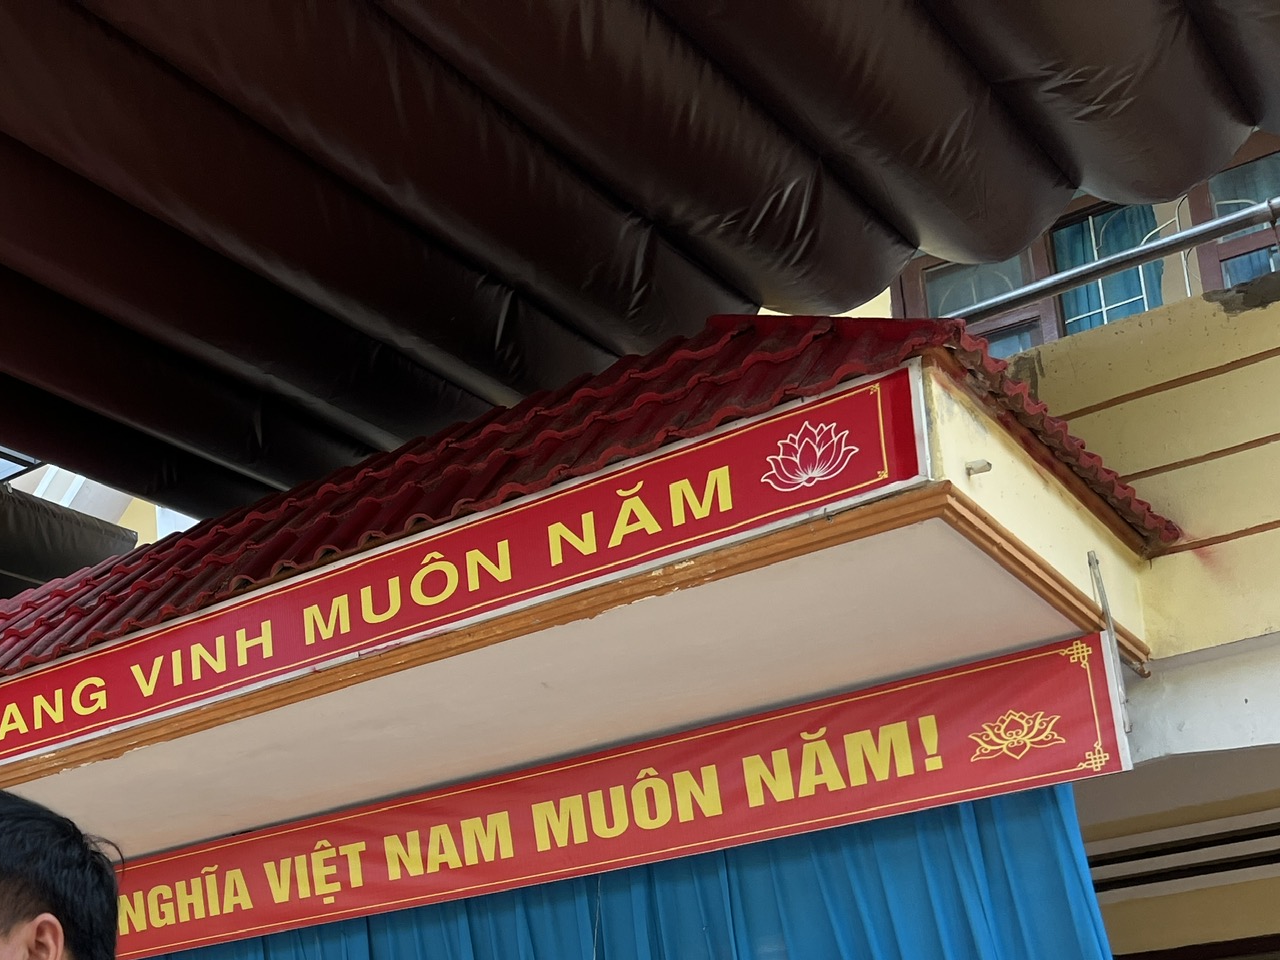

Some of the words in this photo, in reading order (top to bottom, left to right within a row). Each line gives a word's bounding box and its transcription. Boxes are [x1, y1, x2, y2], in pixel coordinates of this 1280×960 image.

[130, 619, 276, 699] VINH
[303, 539, 514, 645] MUÔN
[547, 465, 736, 567] NĂM
[118, 864, 253, 936] NGHĨA
[263, 840, 367, 905] VIỆT
[383, 810, 514, 881] NAM
[531, 764, 723, 852] MUÔN
[741, 714, 944, 808] NĂM!
